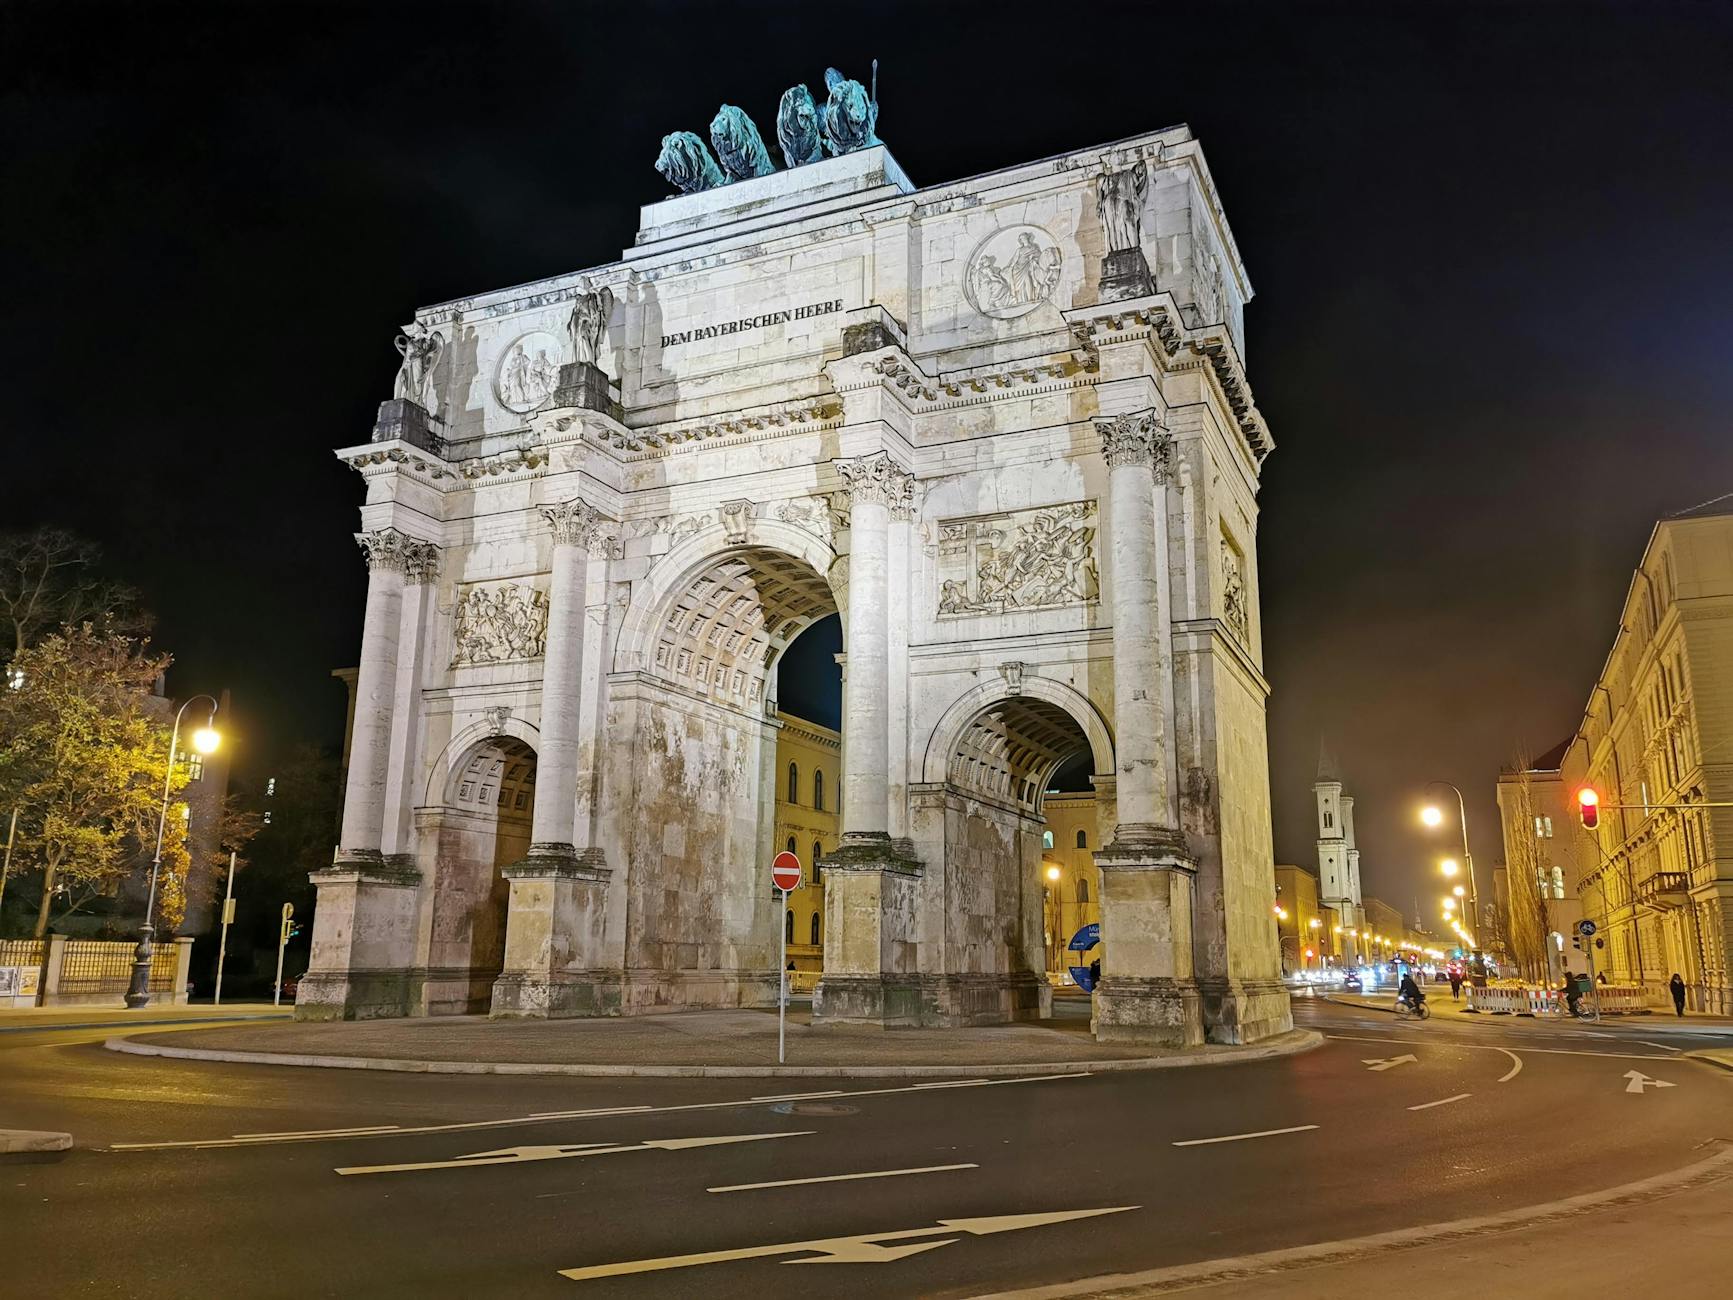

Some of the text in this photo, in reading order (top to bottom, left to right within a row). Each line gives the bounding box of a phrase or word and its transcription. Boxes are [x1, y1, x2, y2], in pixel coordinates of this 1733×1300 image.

[660, 299, 844, 348] DEM BAYERISCHEN HEERE
